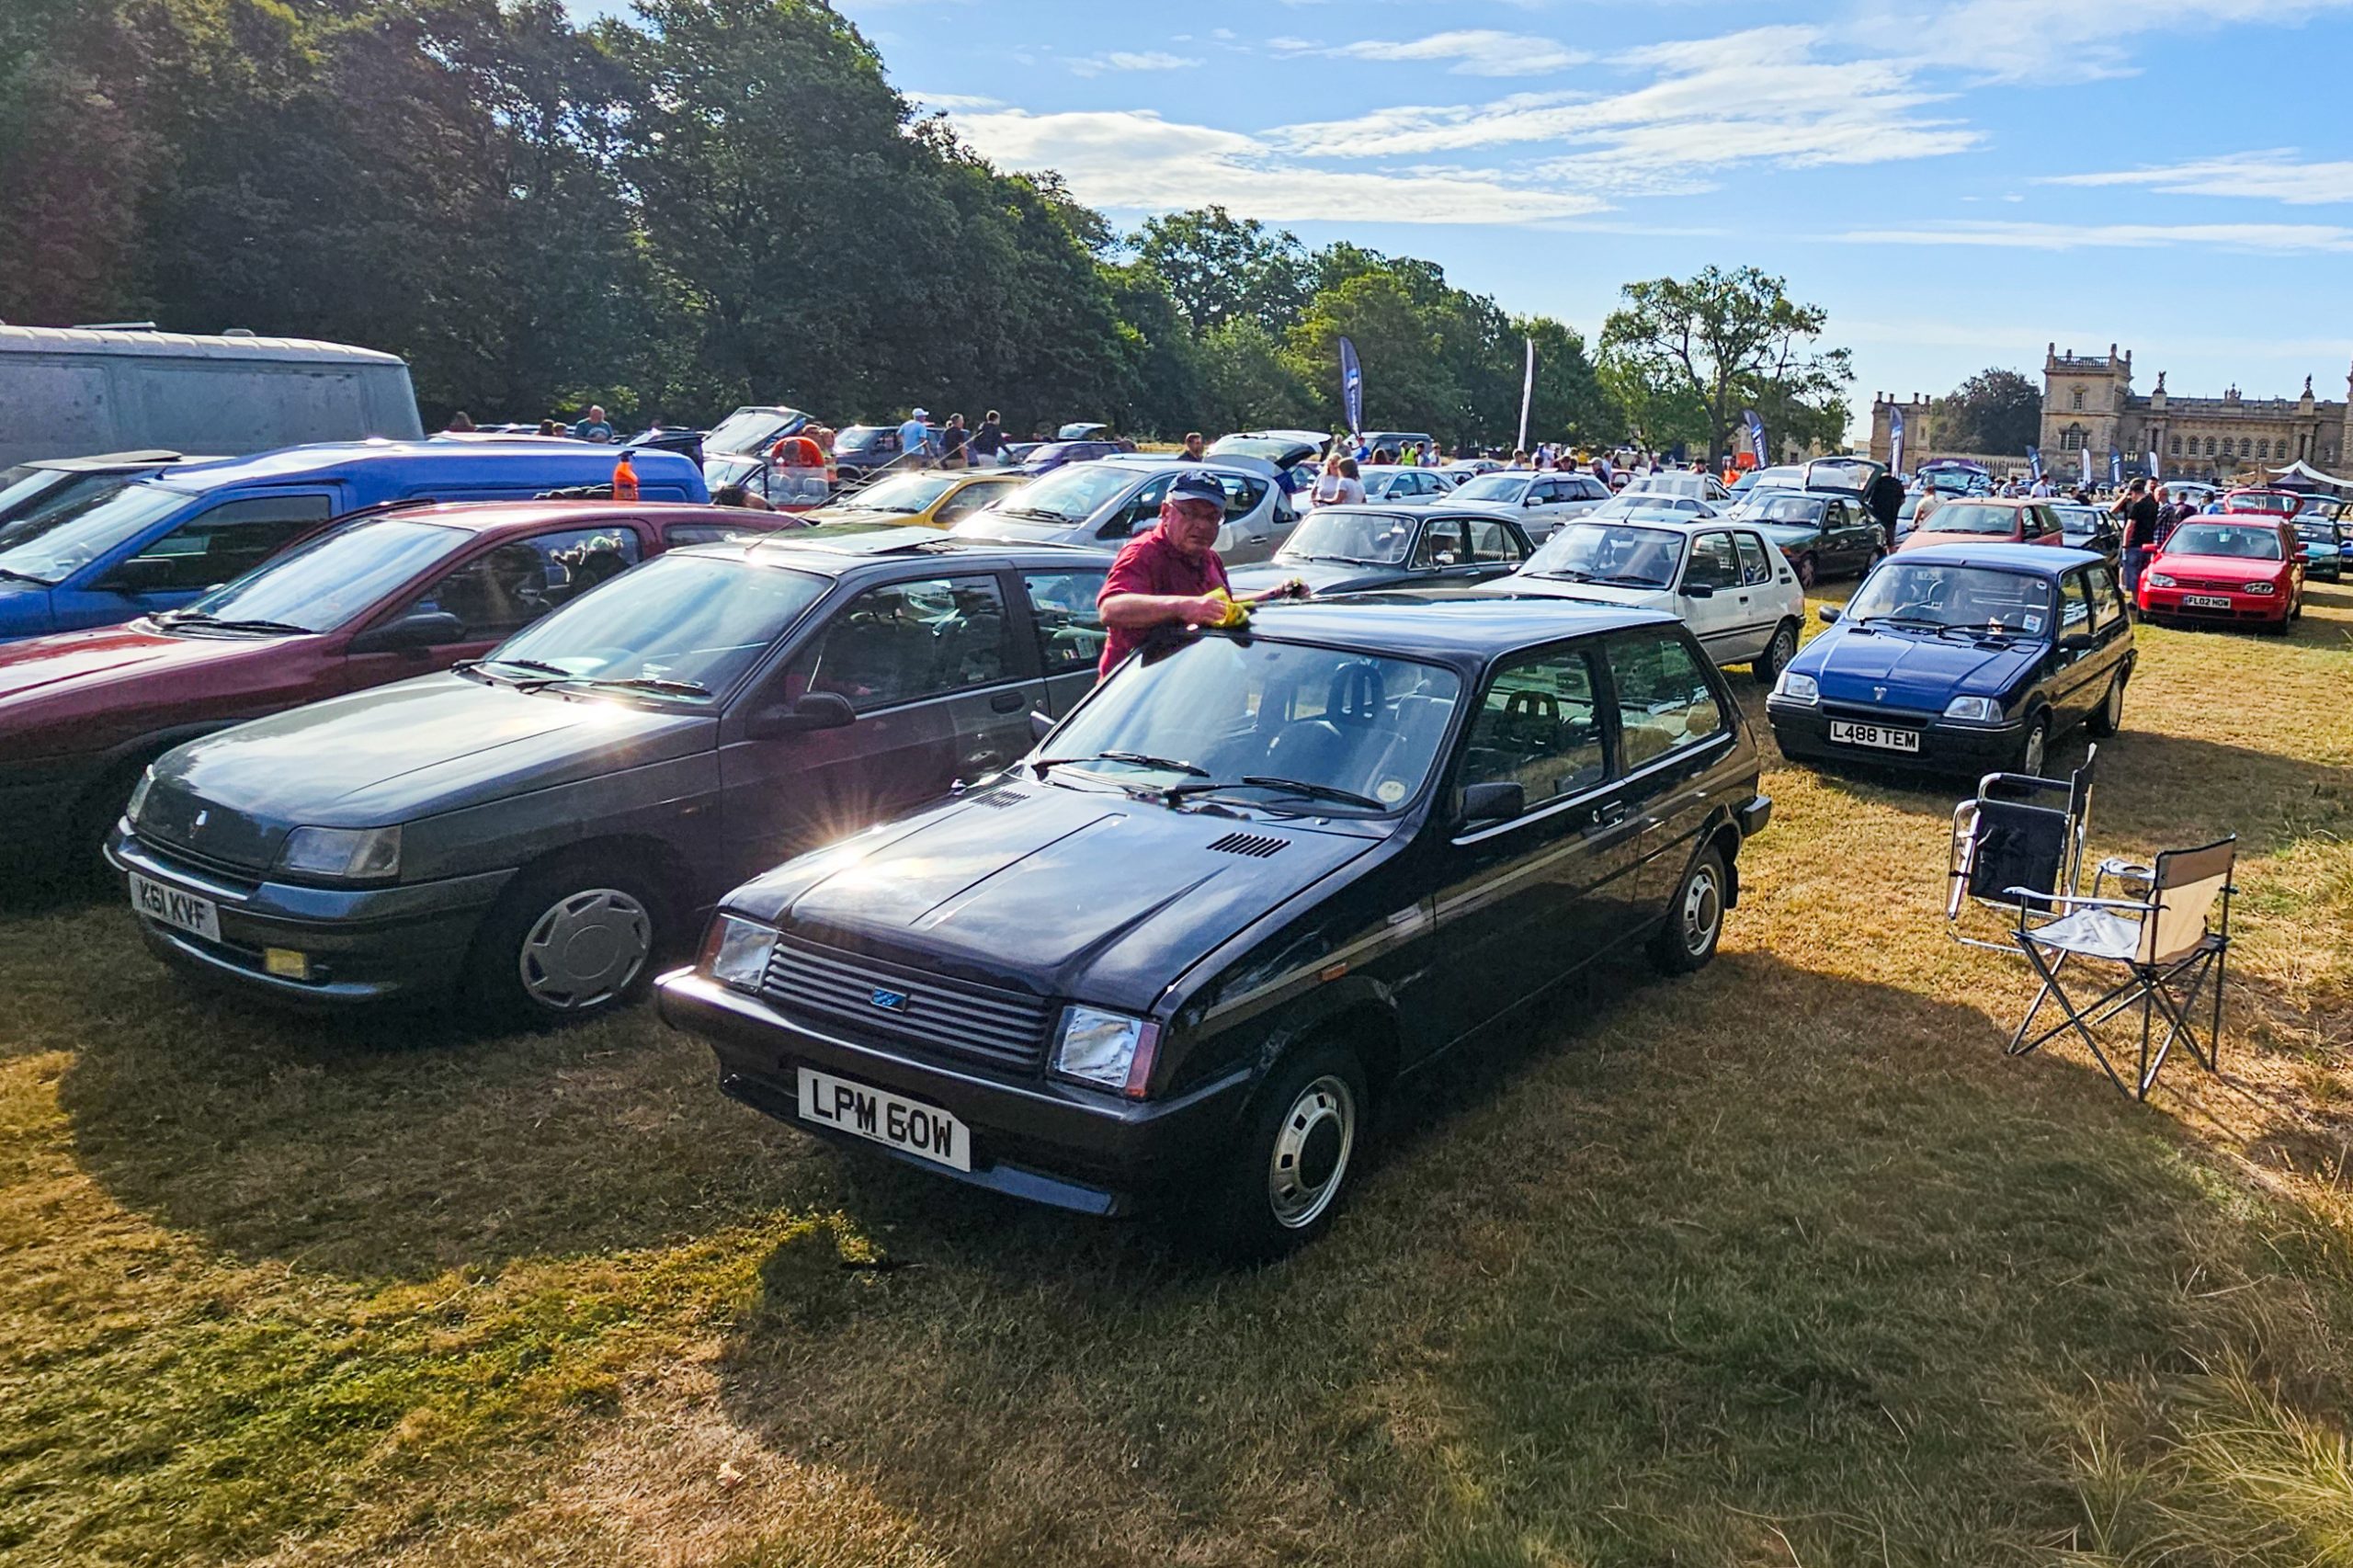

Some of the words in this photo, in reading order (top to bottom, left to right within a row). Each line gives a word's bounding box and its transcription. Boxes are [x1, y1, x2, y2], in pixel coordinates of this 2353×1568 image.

[2188, 597, 2211, 606] FL02
[1834, 722, 1877, 743] L488
[1882, 729, 1916, 748] TEM
[139, 880, 166, 916] K61
[169, 892, 205, 929] KVF
[813, 1078, 876, 1134] LPM
[887, 1102, 952, 1158] 60W
